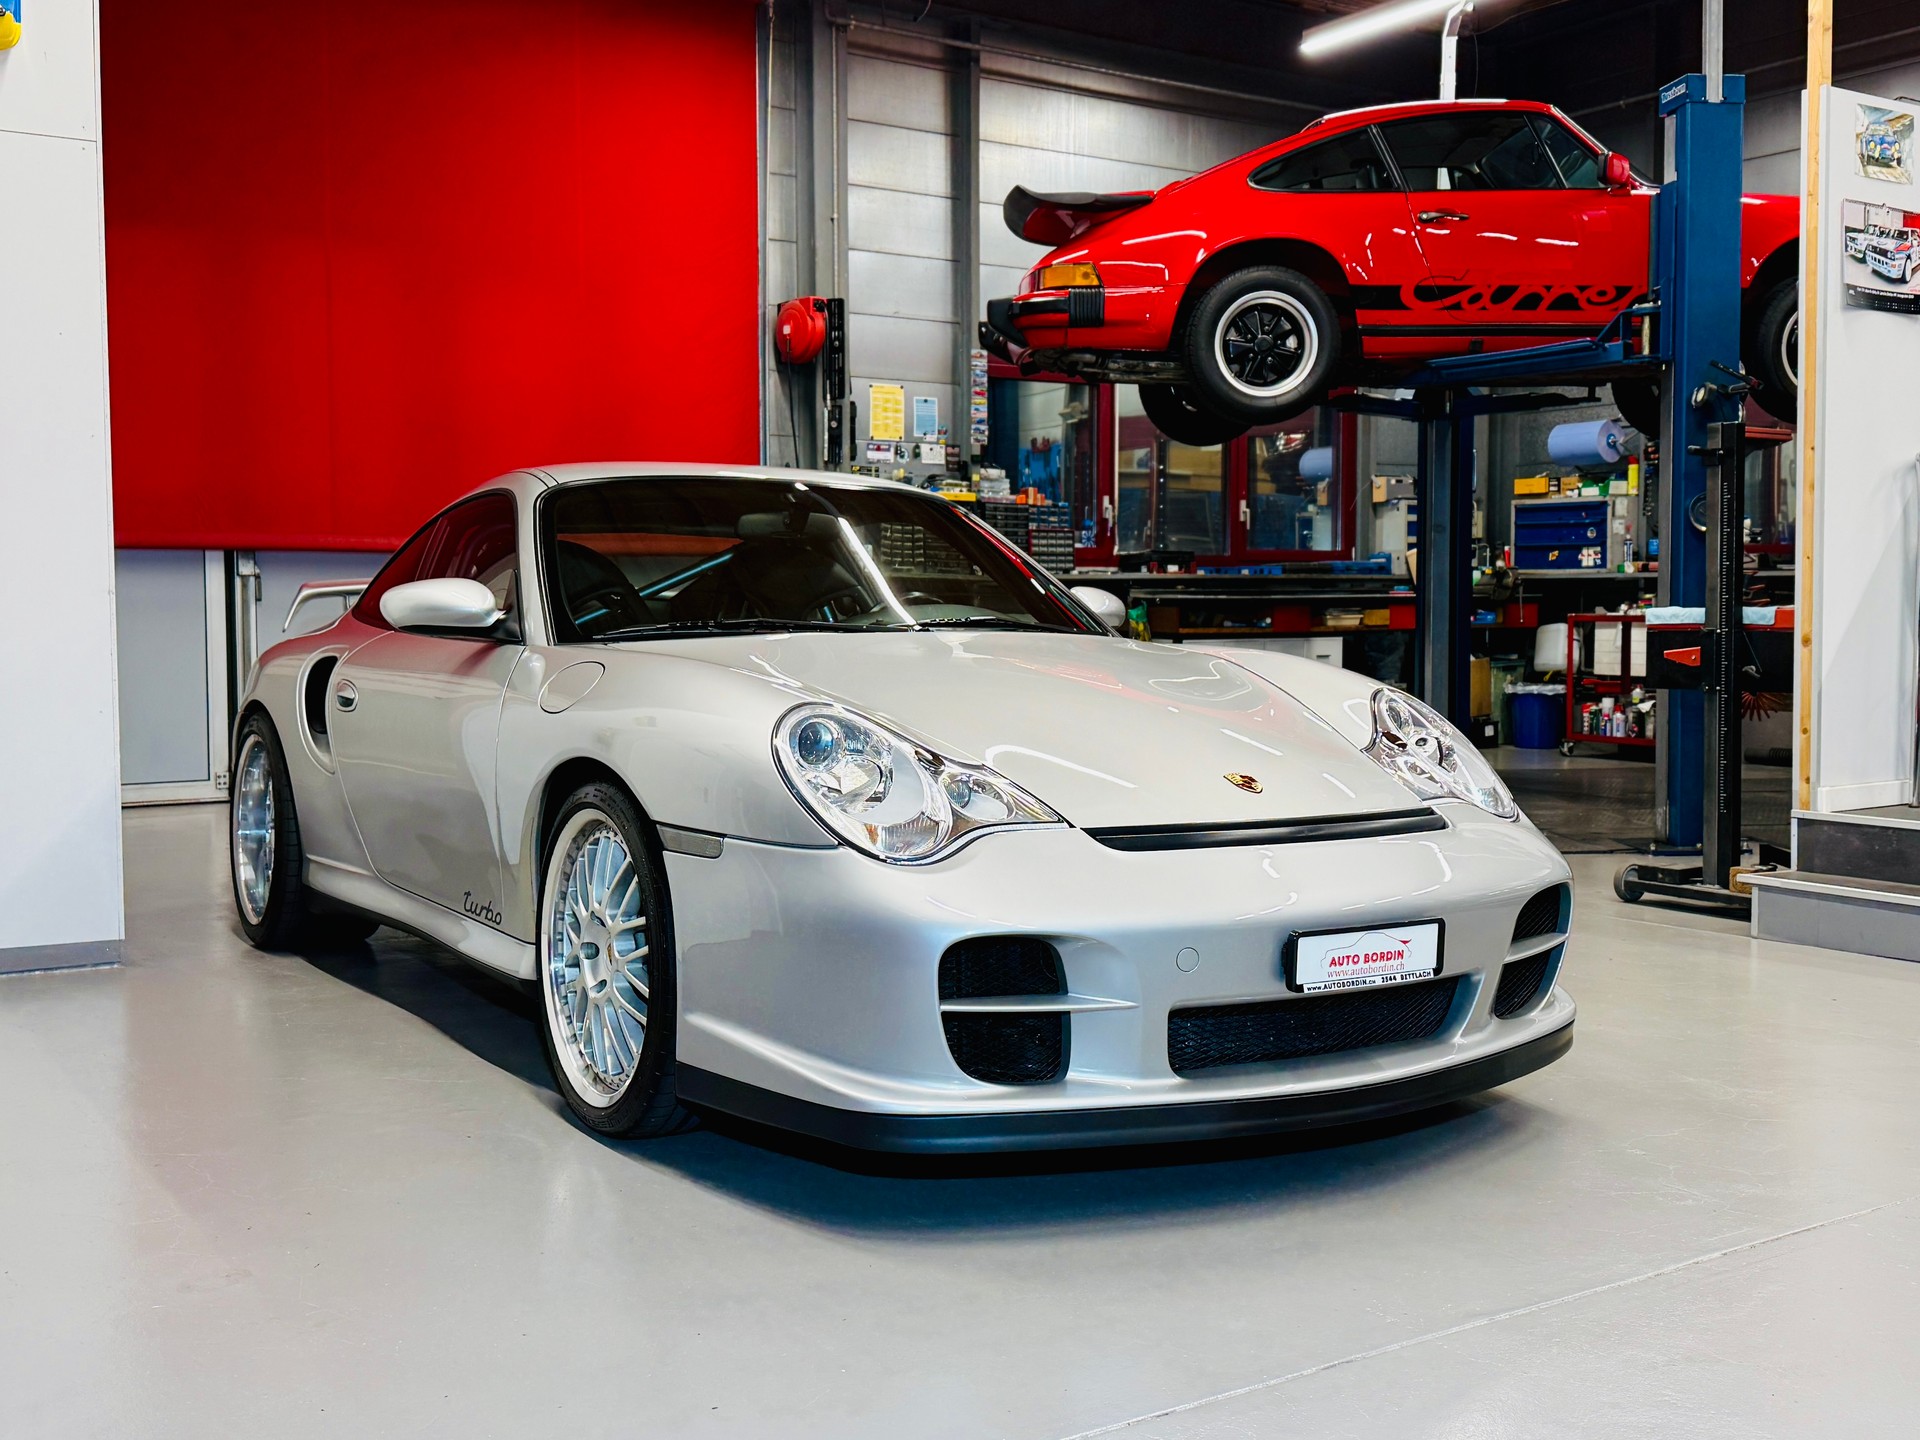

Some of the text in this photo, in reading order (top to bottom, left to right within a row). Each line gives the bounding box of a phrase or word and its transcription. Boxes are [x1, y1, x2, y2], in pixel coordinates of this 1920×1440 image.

[463, 890, 502, 925] turbo
[1329, 949, 1405, 968] AUTO BORDIN
[1327, 961, 1405, 979] www.autobordin.ch
[1400, 970, 1432, 982] BETTLACH
